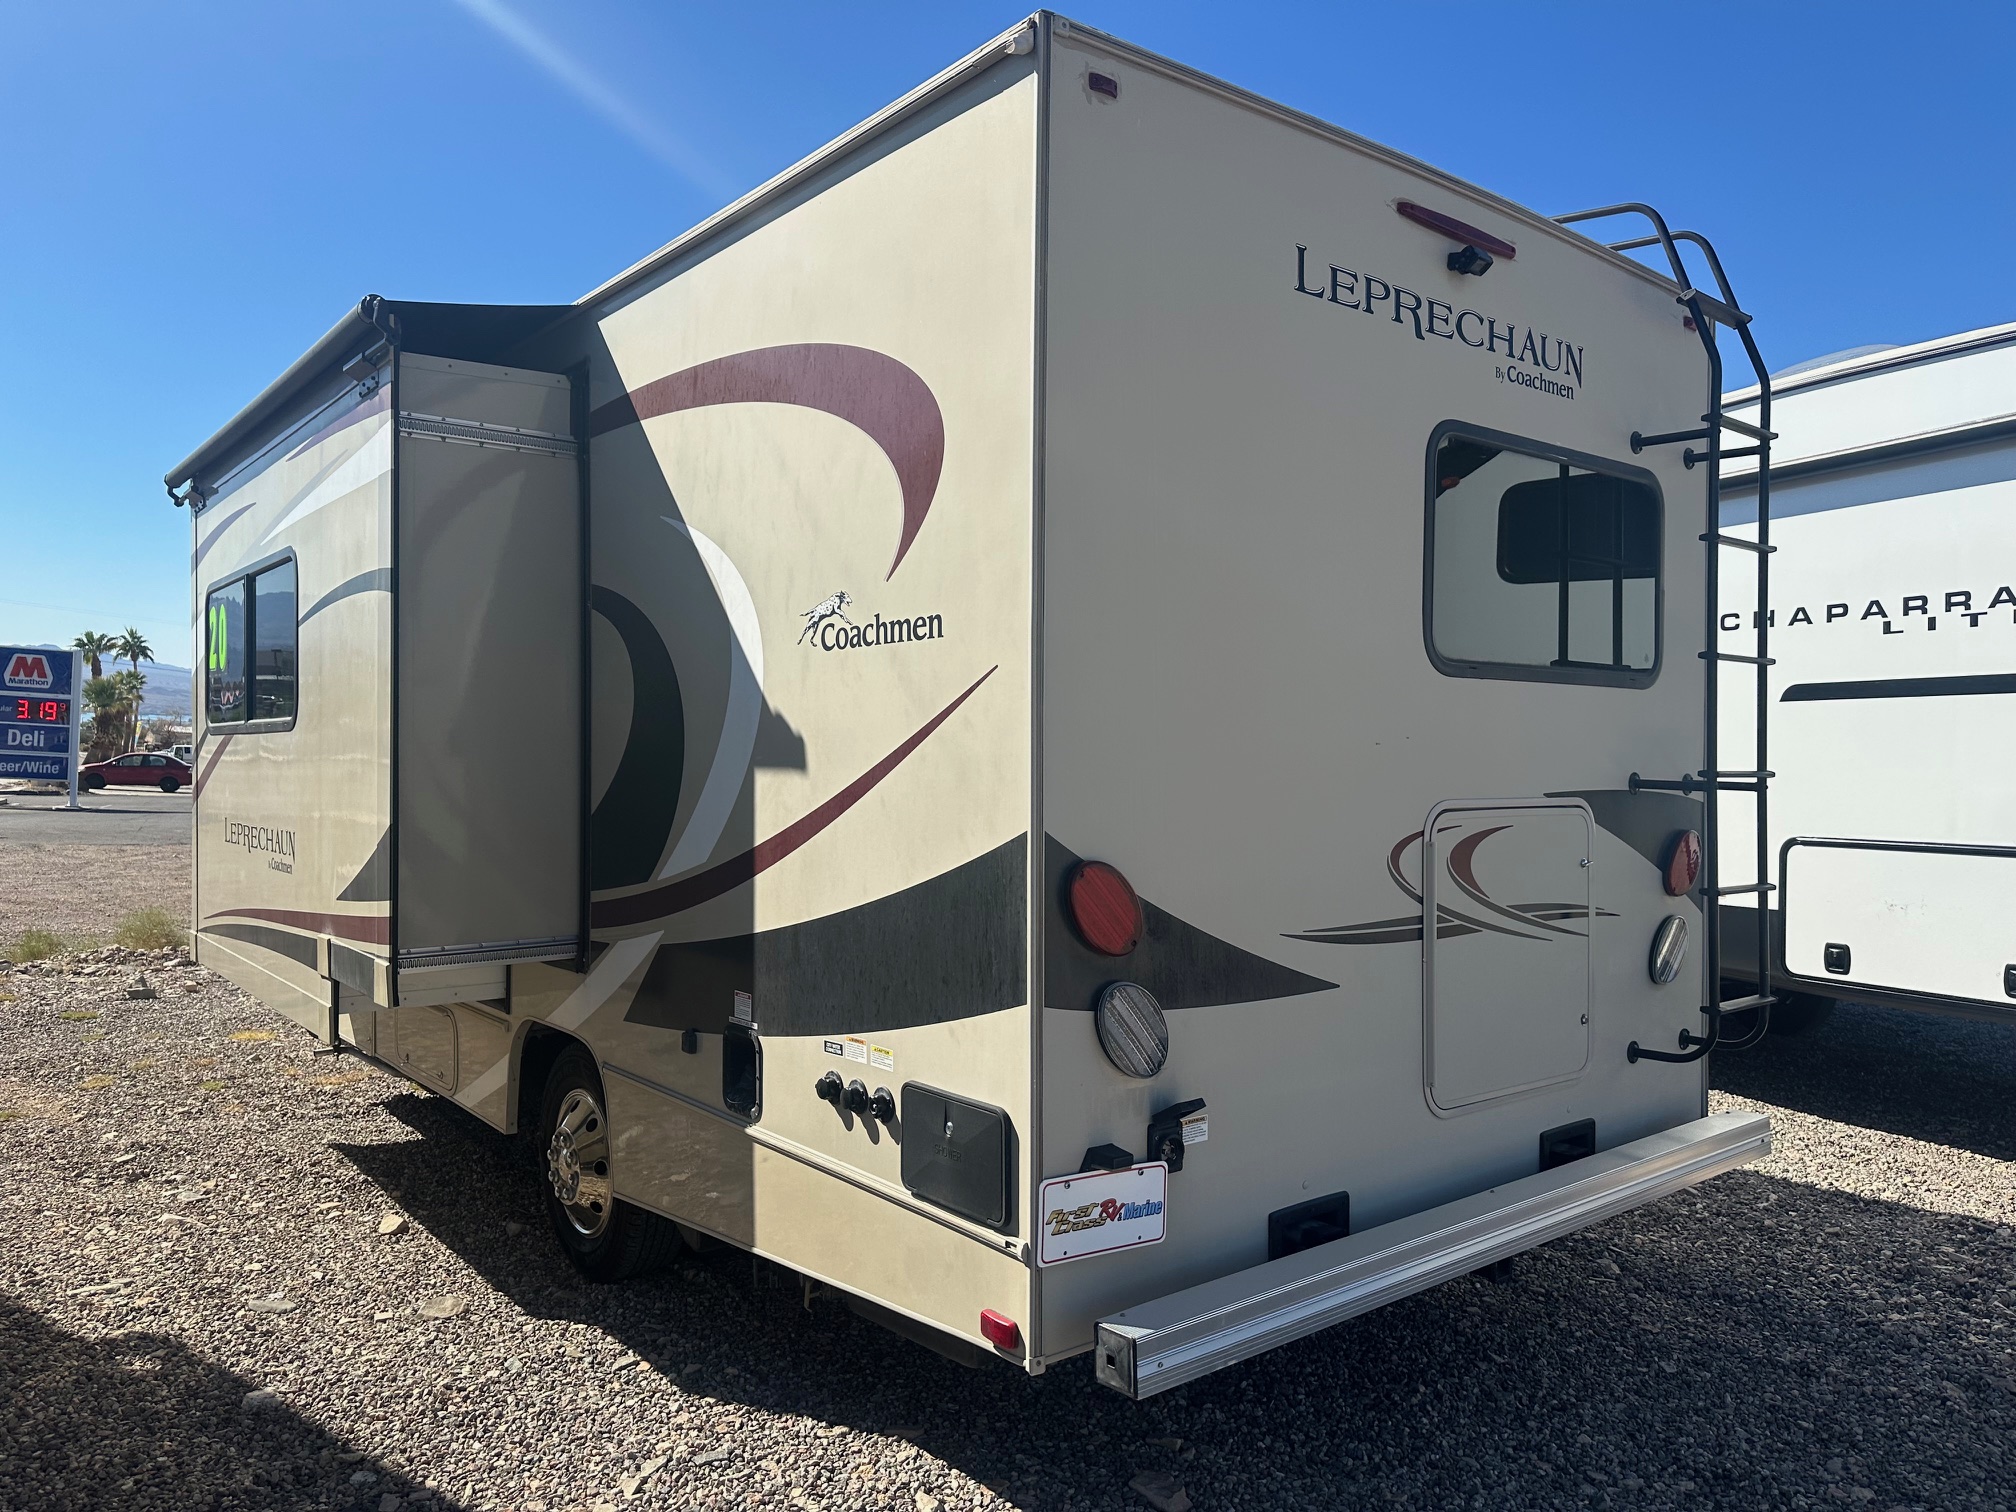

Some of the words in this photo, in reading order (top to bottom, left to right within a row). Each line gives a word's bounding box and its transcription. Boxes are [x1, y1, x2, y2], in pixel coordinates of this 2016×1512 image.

[1294, 243, 1584, 389] LEPRECHAUN
[1495, 366, 1506, 383] By
[1507, 366, 1575, 400] Coachmen
[821, 613, 944, 651] Coachmen
[1883, 609, 2016, 635] LIT
[209, 603, 227, 672] 20
[8, 677, 49, 686] Marathon
[7, 729, 45, 747] Deli
[224, 817, 296, 865] LEPRECHAUN
[934, 1143, 962, 1163] SHOWER
[1046, 1202, 1100, 1226] First
[1099, 1198, 1126, 1222] RV
[1122, 1199, 1163, 1221] Marine
[1051, 1215, 1108, 1236] Class
